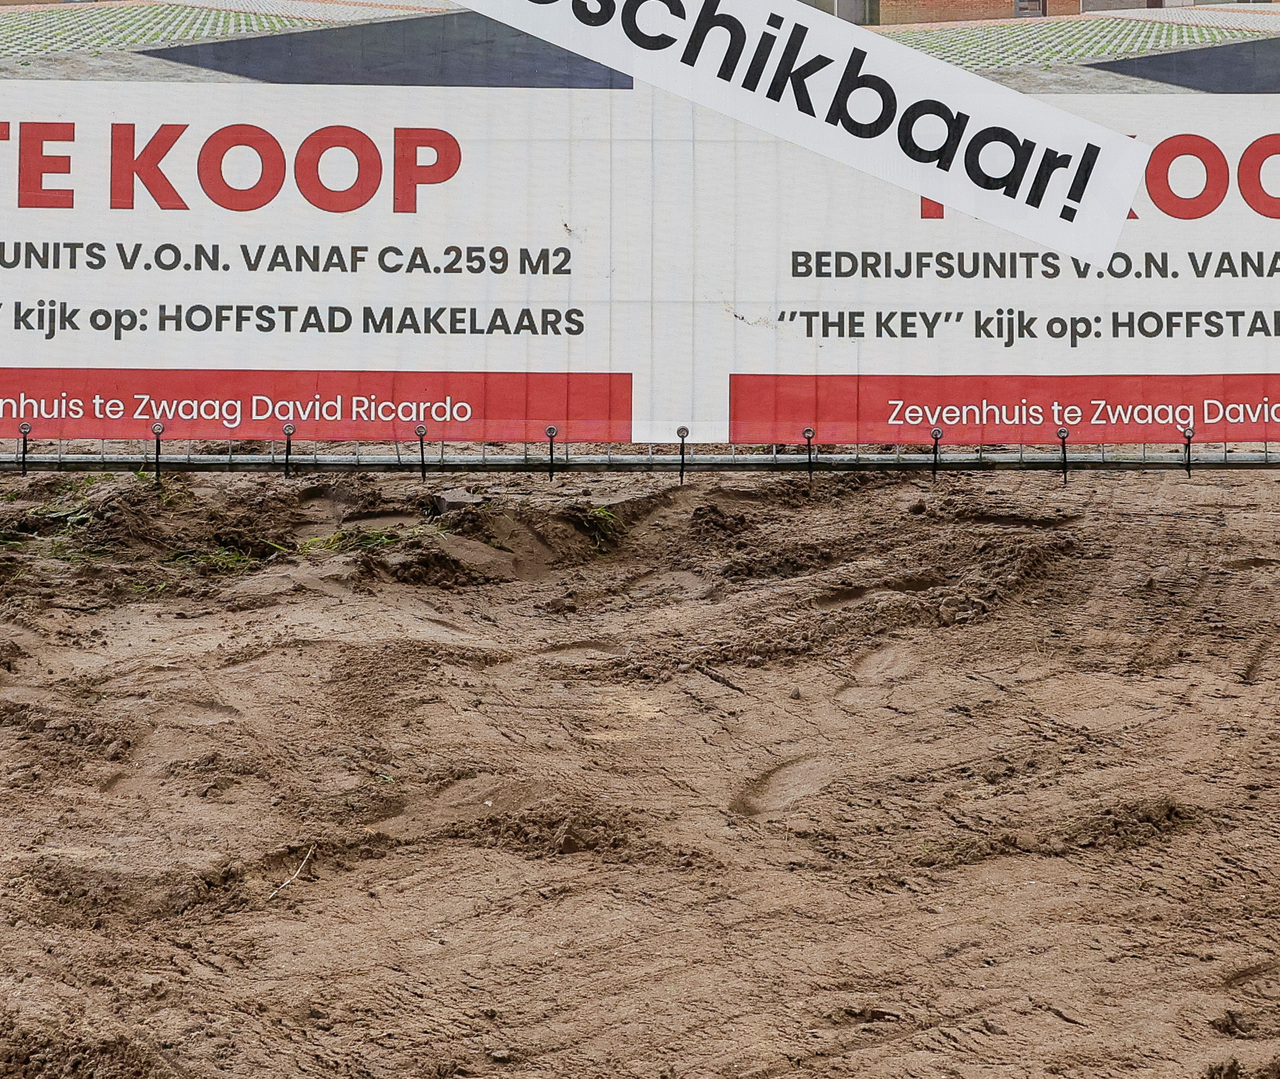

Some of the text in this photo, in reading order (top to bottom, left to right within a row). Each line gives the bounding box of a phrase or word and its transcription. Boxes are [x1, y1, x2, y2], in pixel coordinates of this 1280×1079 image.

[110, 123, 462, 214] KOOP
[115, 243, 230, 272] V.O.N.
[240, 244, 369, 273] VANAF
[377, 245, 509, 275] CA.259
[519, 246, 572, 275] M2
[791, 251, 1061, 279] BEDRIJFSUNITS
[14, 299, 81, 340] kijk
[89, 308, 148, 341] op:
[158, 304, 353, 333] HOFFSTAD
[362, 306, 584, 336] MAKELAARS
[974, 308, 1038, 348] kijk
[1046, 315, 1102, 348] op:
[92, 394, 125, 419] te
[133, 394, 242, 428] Zwaag
[251, 394, 342, 421] David
[352, 394, 472, 422] Ricardo
[887, 399, 1044, 426] Zevenhuis
[1051, 401, 1082, 426] te
[1090, 400, 1194, 433] Zwaag
